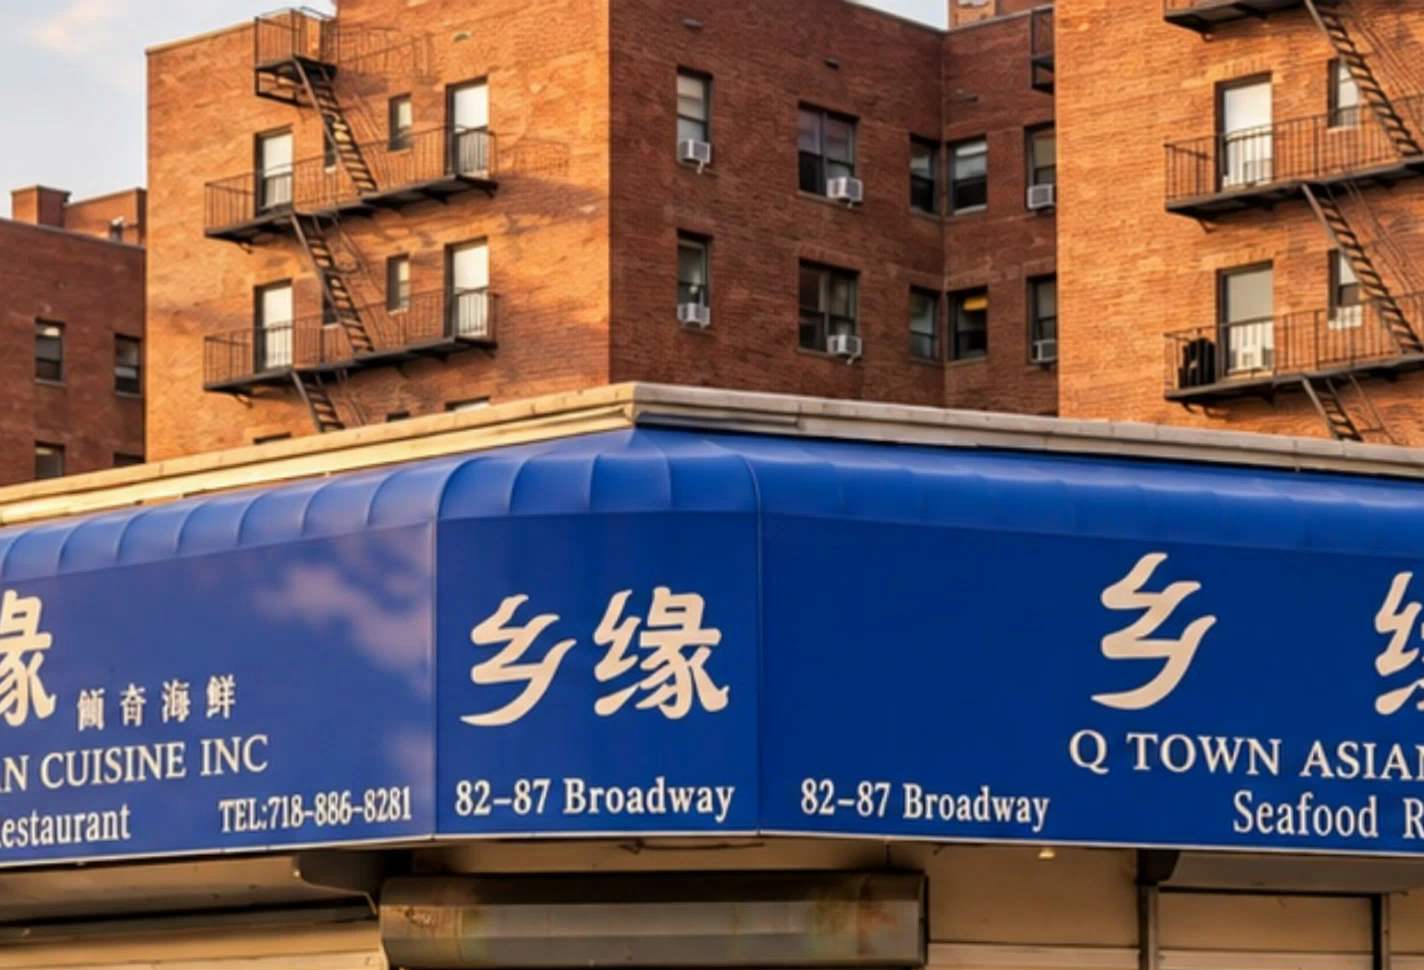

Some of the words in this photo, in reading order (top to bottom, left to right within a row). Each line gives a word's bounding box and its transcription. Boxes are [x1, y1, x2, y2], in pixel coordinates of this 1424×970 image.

[461, 587, 729, 726] 乡缘
[40, 742, 187, 784] CUISINE
[199, 733, 270, 776] INC
[1069, 729, 1110, 774] Q
[1127, 733, 1281, 776] TOWN
[455, 780, 550, 816] 82-87
[563, 777, 735, 822] Broadway
[800, 780, 891, 818] 82-87
[902, 783, 1050, 832] Broadway
[1232, 790, 1378, 839] Seafood
